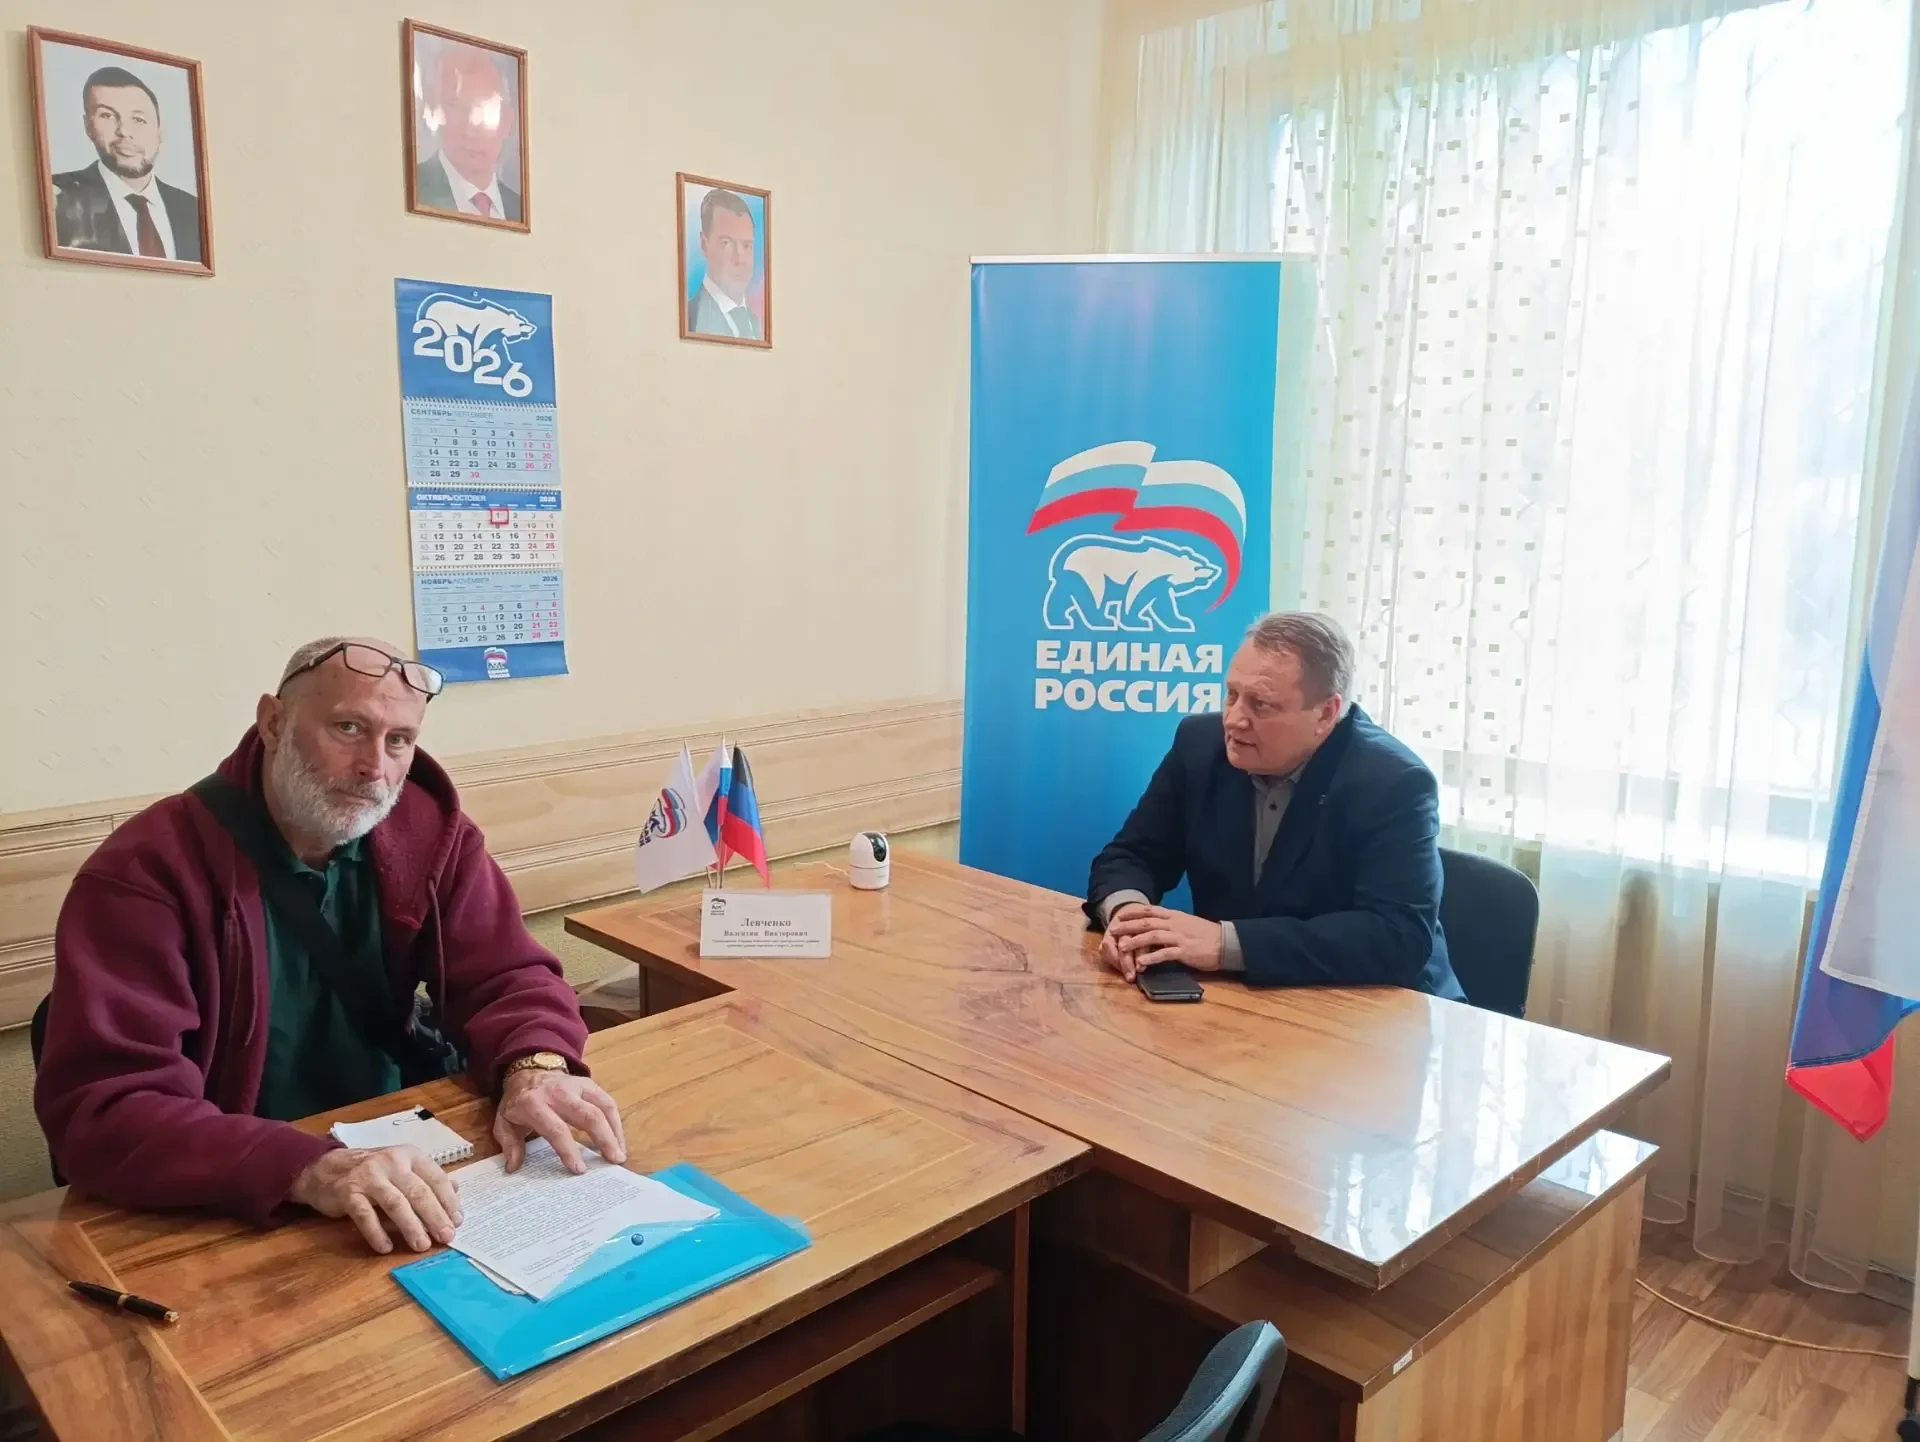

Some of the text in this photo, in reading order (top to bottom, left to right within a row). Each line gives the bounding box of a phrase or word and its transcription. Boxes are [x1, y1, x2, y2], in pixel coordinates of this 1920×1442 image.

[412, 319, 533, 397] 2026
[1036, 640, 1223, 674] ЕДИНАЯ
[1035, 678, 1222, 713] РОССИЯ
[740, 918, 791, 927] Левченко
